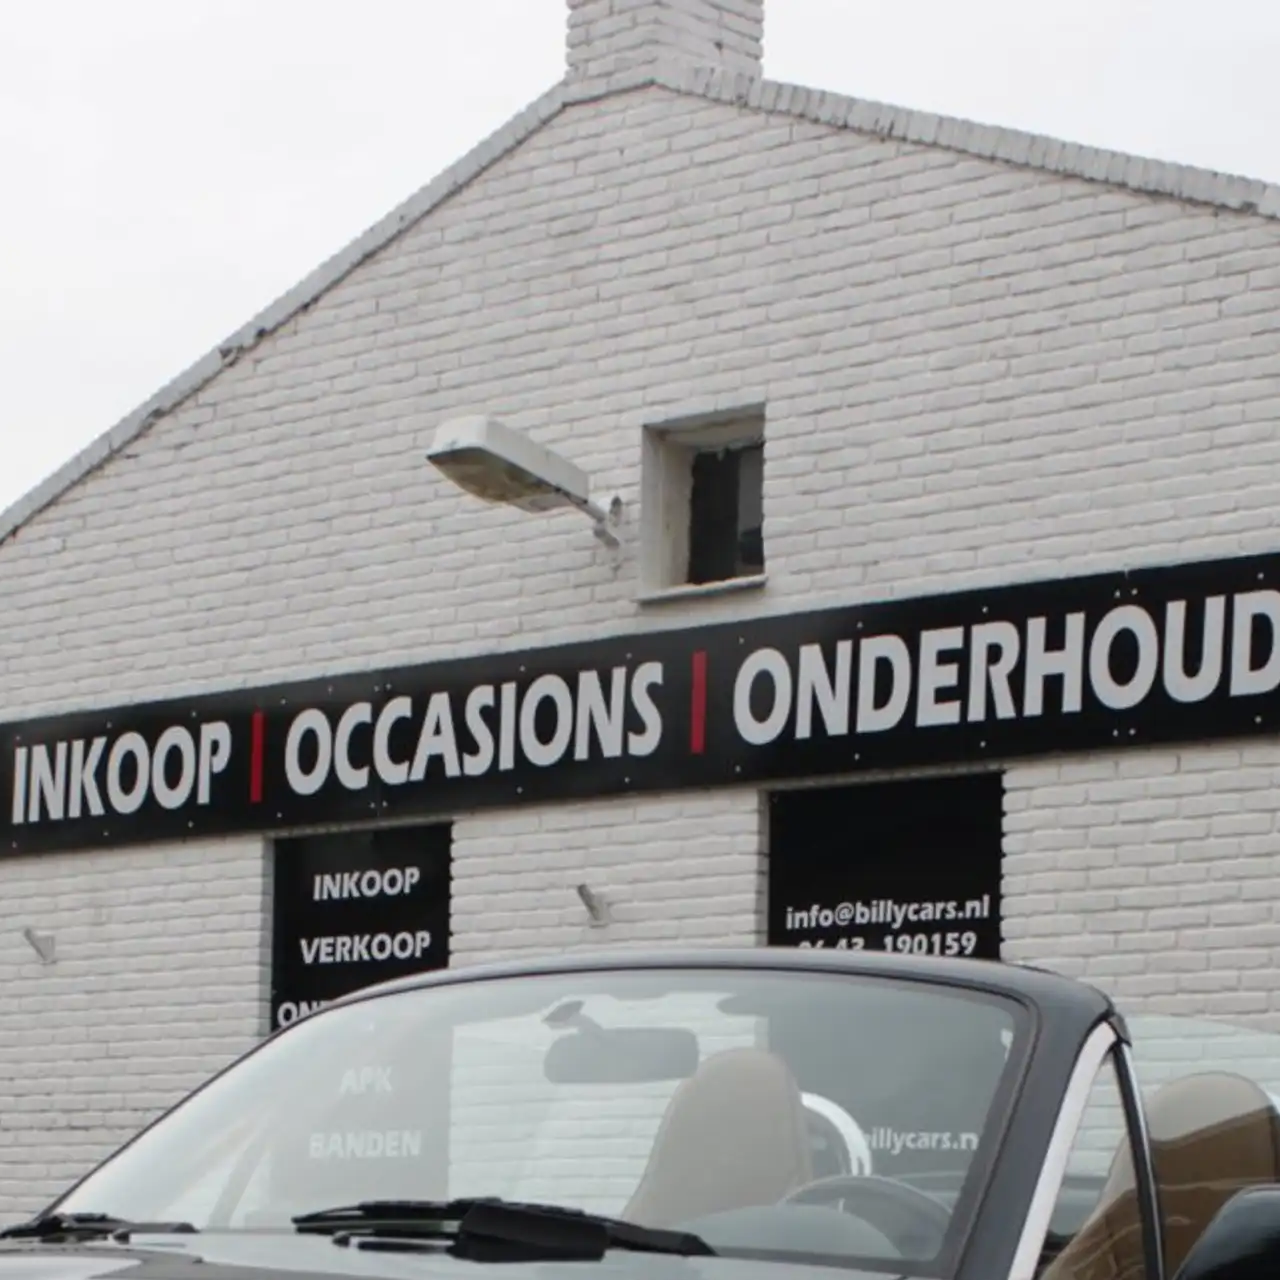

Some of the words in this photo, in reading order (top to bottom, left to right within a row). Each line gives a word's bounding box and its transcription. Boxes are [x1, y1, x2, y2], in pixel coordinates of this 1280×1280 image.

[12, 720, 232, 824] INKOOP
[285, 661, 663, 796] OCCASIONS
[313, 866, 420, 901] INKOOP
[785, 894, 990, 930] info@billycars.nl
[300, 930, 432, 964] VERKOOP
[883, 931, 977, 956] 190159
[338, 1065, 393, 1095] APK
[309, 1129, 421, 1160] BANDEN
